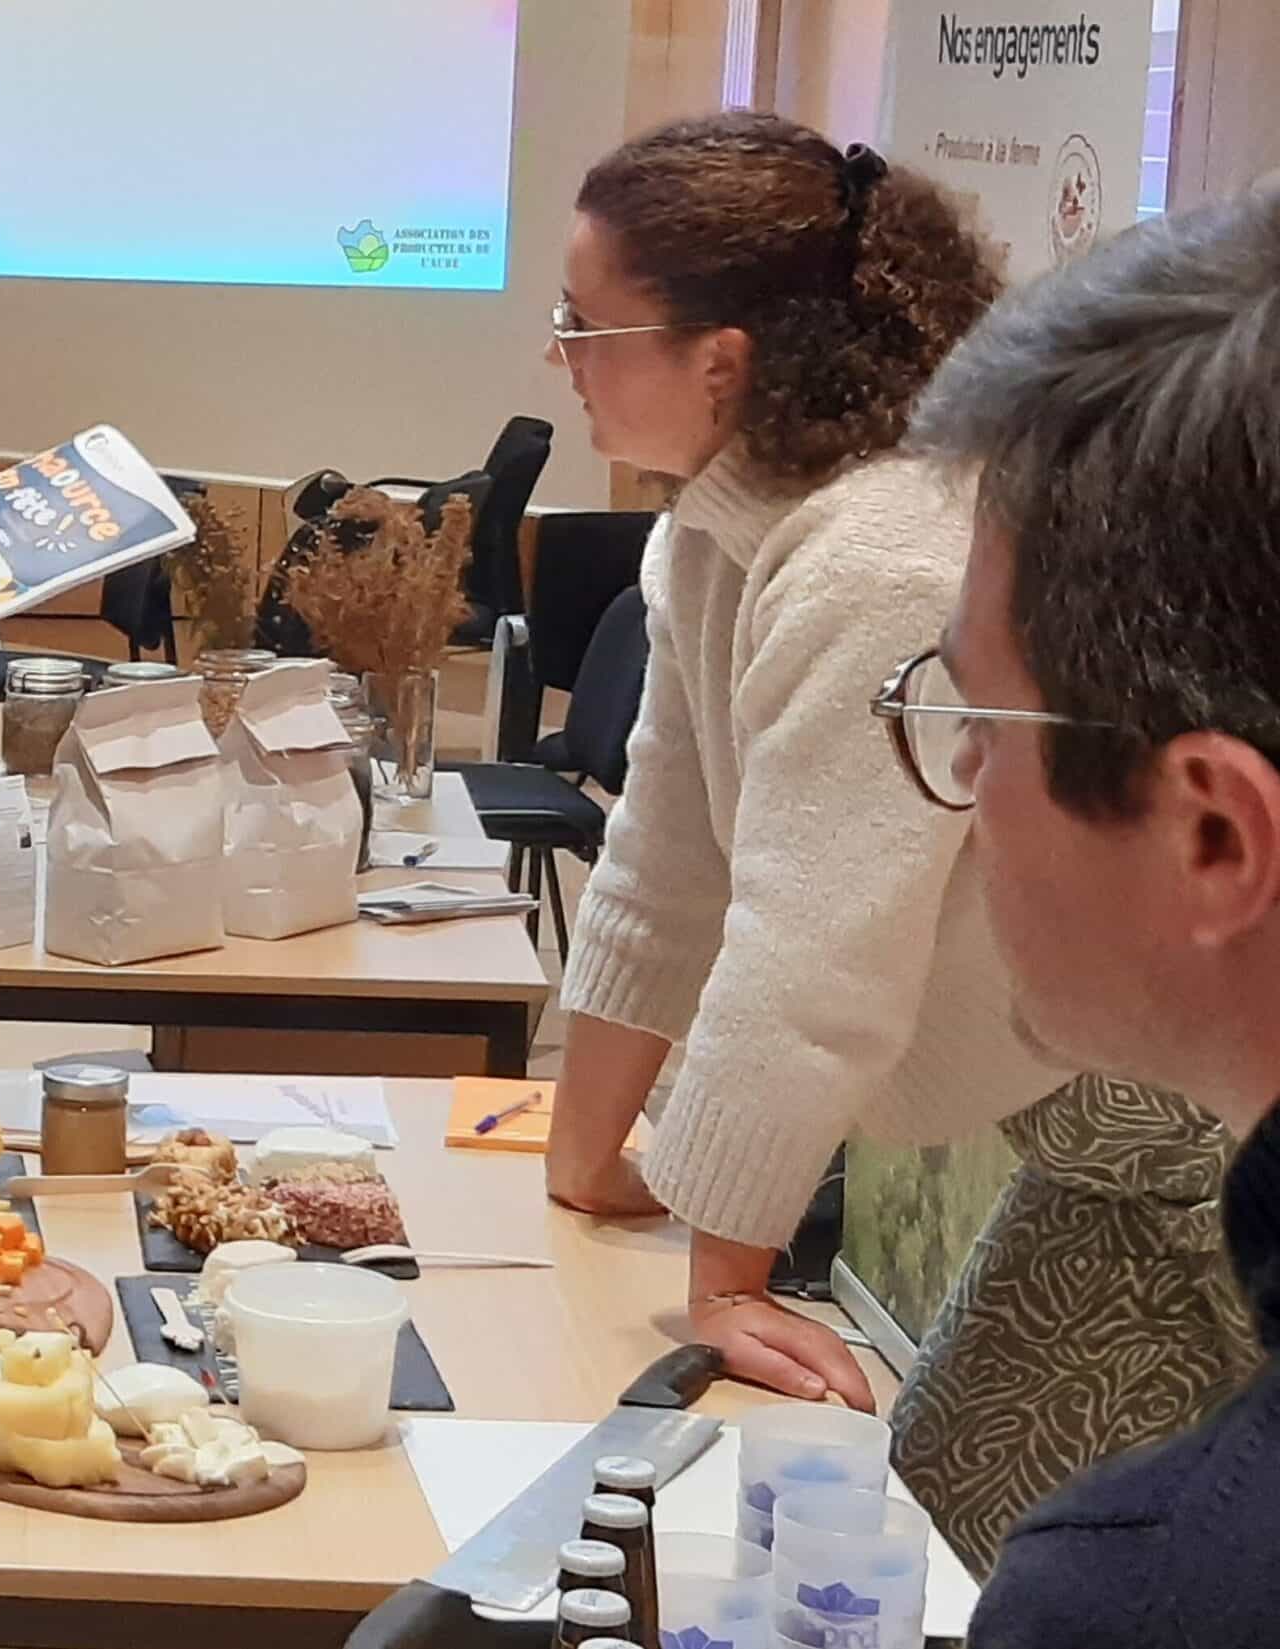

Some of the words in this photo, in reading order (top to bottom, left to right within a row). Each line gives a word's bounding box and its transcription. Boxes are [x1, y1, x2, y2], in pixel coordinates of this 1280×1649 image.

[938, 13, 972, 64] Nos
[974, 13, 1101, 79] engagements
[393, 228, 465, 240] ASSOCIATION
[469, 229, 490, 240] DES
[393, 243, 472, 254] PRODUCTEURS
